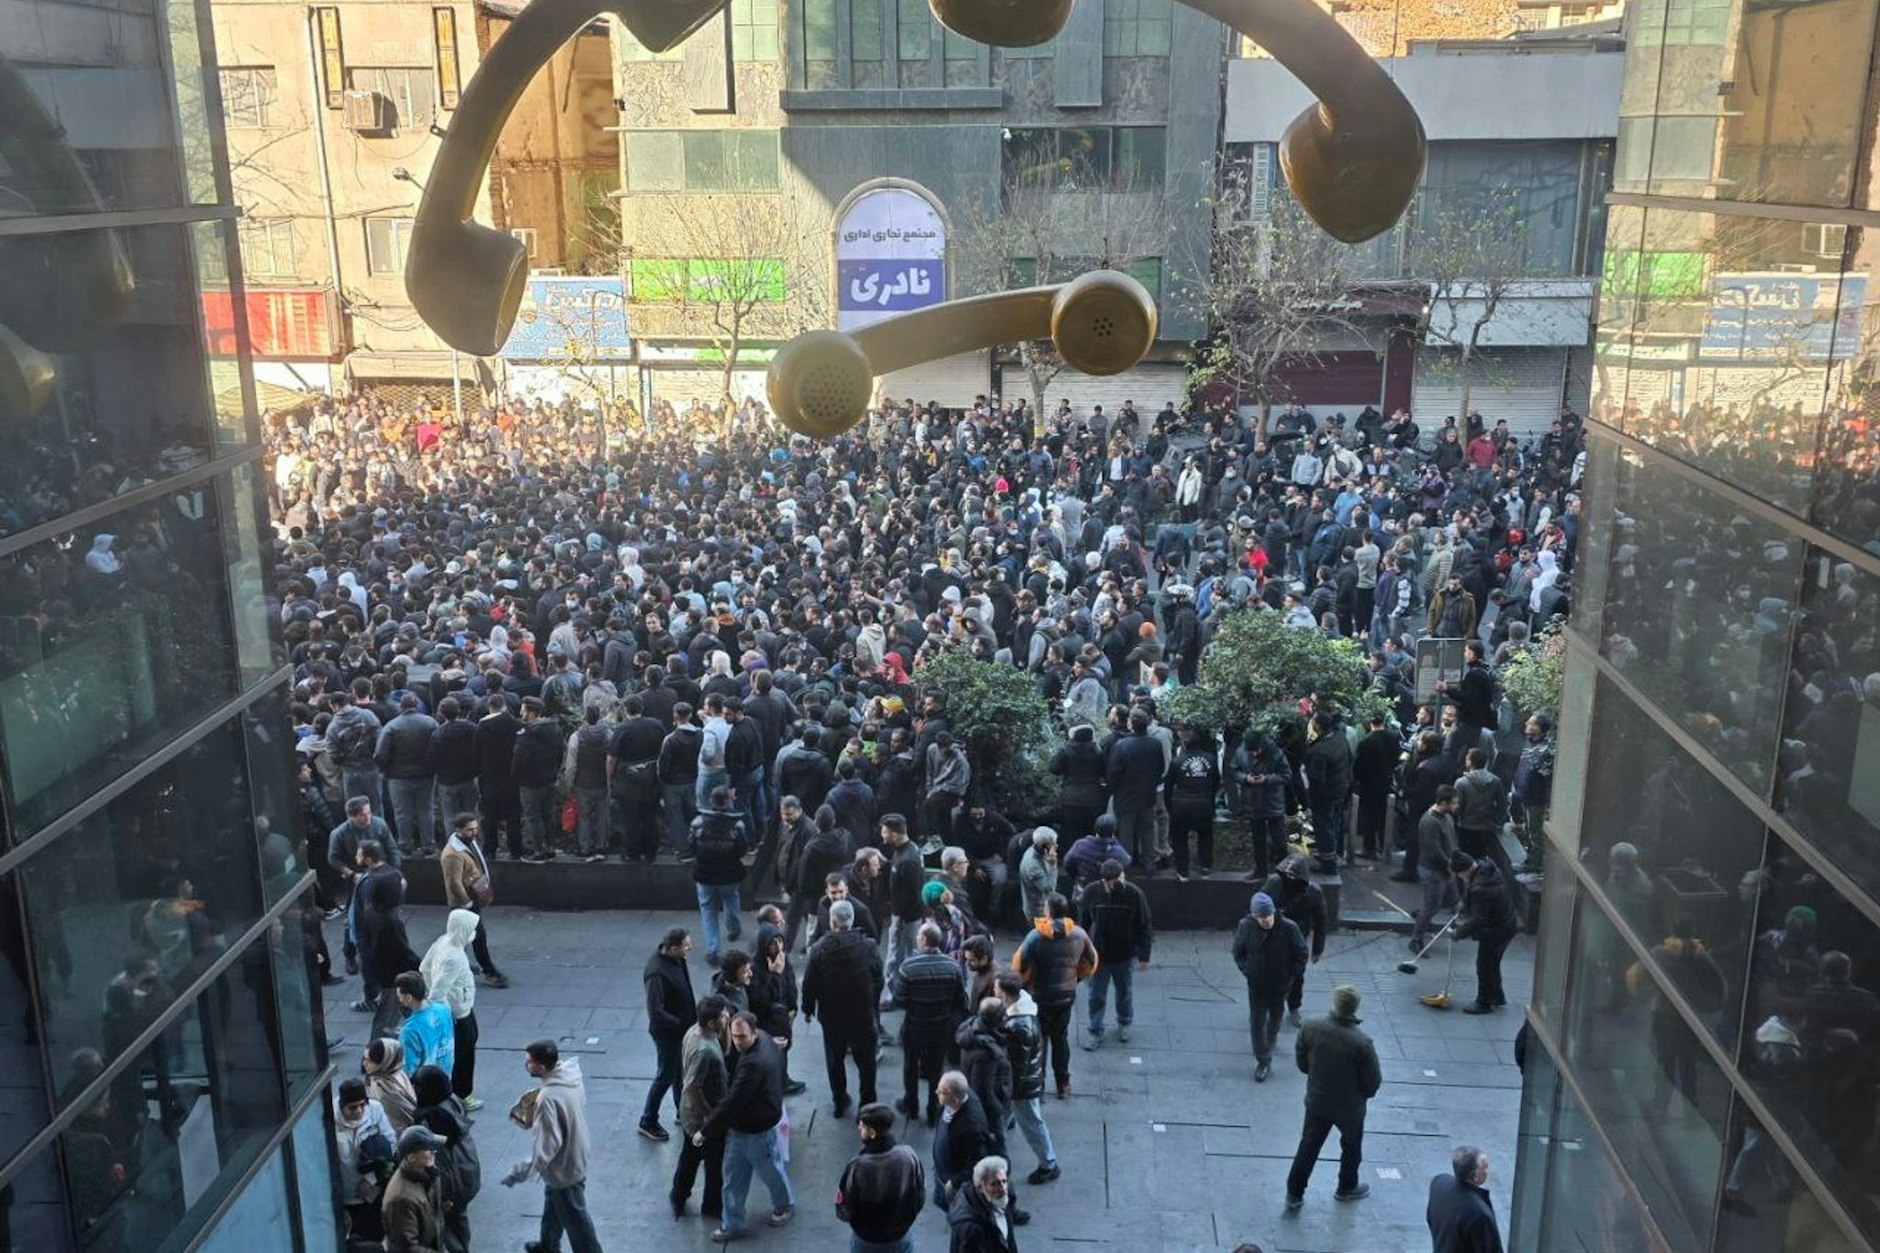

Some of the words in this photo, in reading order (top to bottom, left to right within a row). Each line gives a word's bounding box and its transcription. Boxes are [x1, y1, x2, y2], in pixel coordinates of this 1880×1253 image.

[844, 228, 871, 242] اداری
[902, 227, 936, 242] مجتمع
[851, 267, 931, 306] نادری
